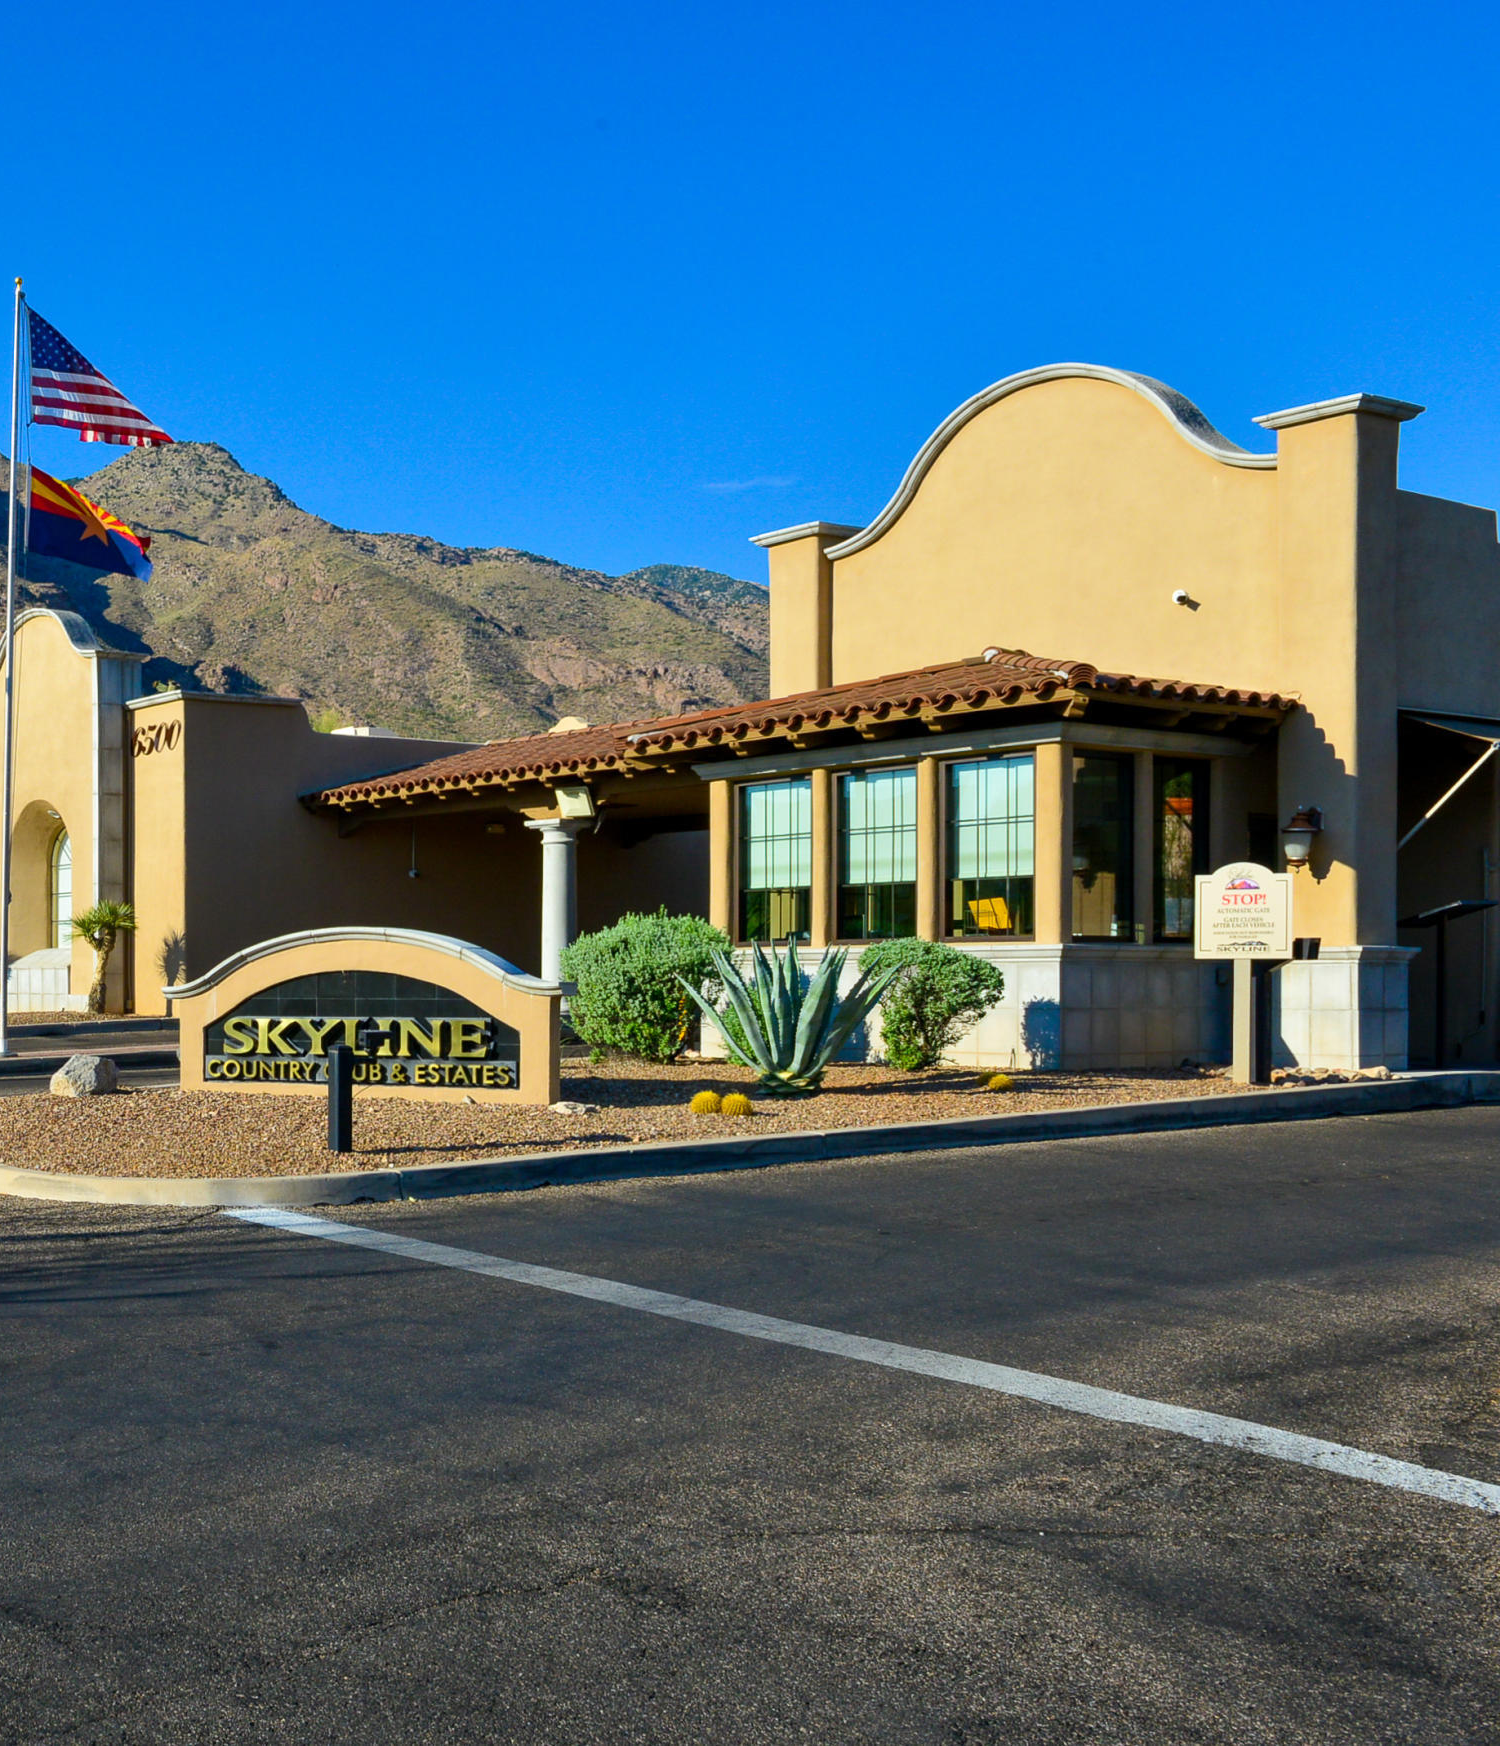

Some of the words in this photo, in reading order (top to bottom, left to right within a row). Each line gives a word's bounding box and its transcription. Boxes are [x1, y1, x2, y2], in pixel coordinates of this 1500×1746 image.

[131, 719, 181, 758] 6500
[1221, 893, 1267, 906] STOP!
[223, 1017, 488, 1058] SKYLINE
[207, 1059, 316, 1081] COUNTRY
[323, 1062, 382, 1082] UB
[390, 1063, 405, 1082] &
[414, 1063, 510, 1085] ESTATES
